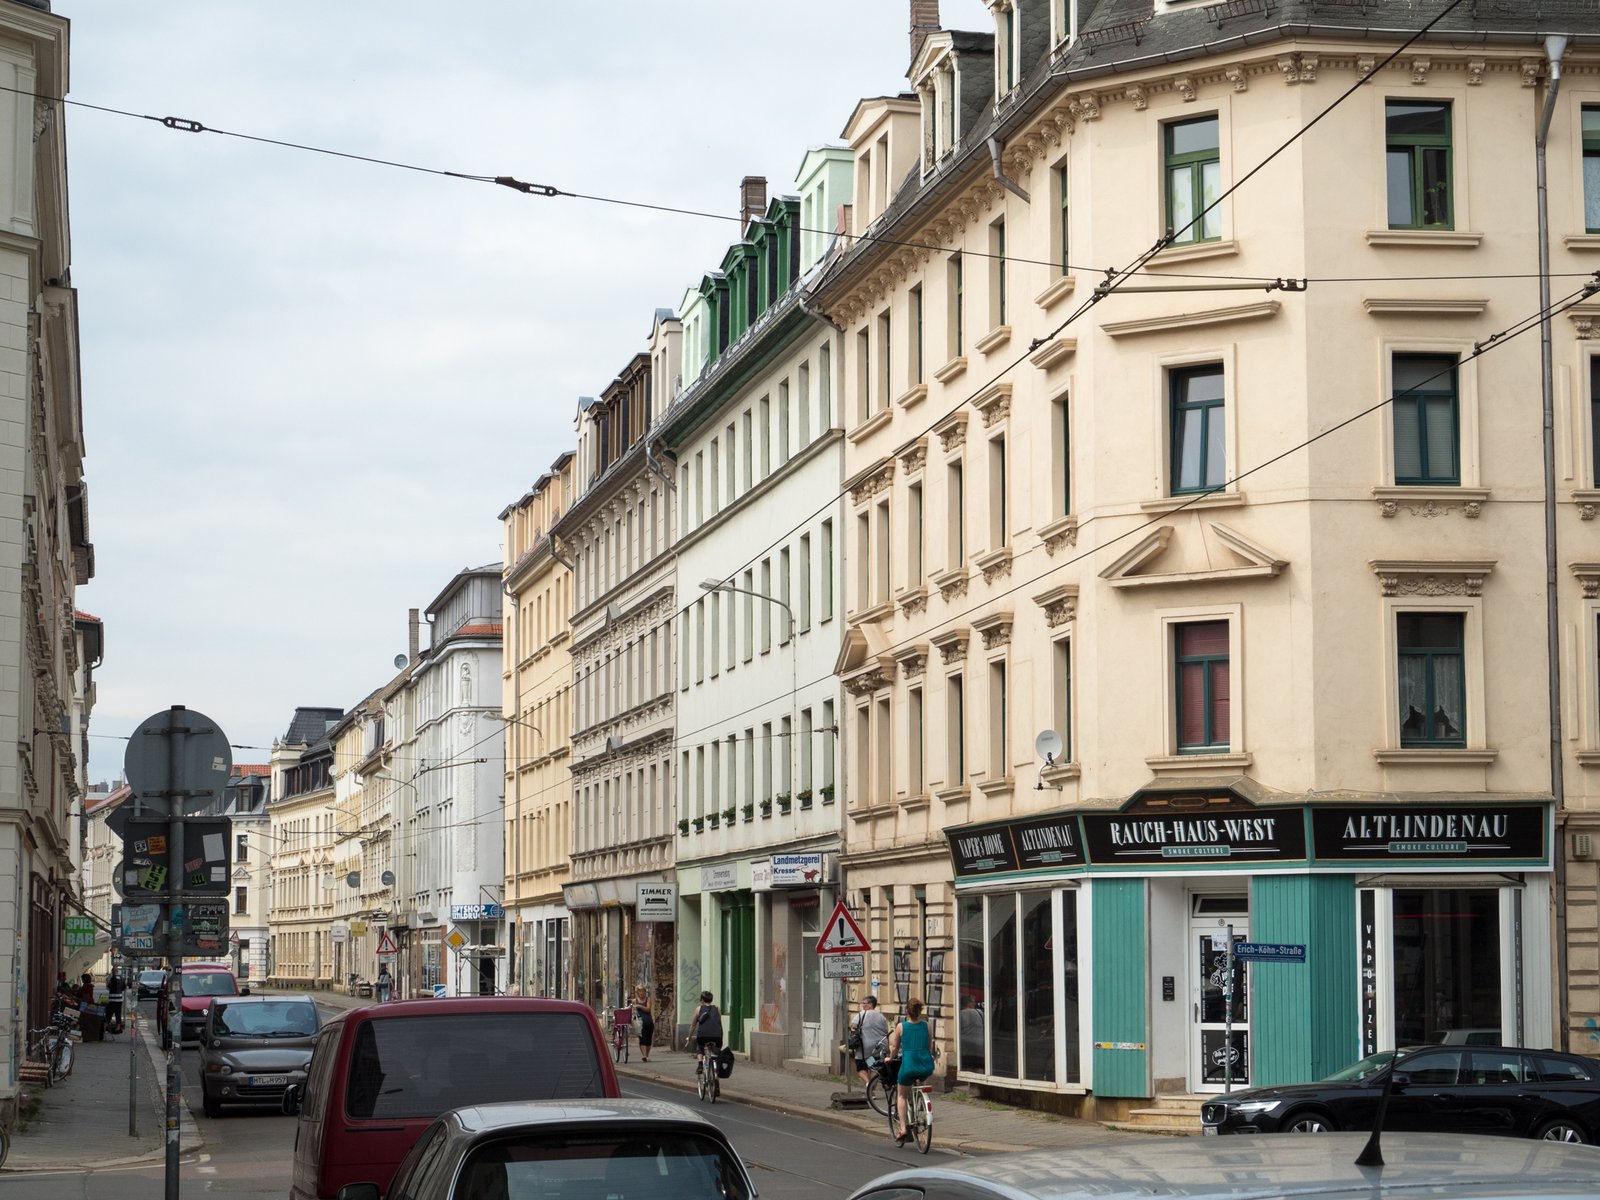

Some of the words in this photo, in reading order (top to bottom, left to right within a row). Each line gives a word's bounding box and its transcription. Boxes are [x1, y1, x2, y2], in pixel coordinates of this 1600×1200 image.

[1110, 818, 1275, 845] RAUCH-HAUS-WEST
[1342, 814, 1508, 838] ALTLINDENAU
[983, 833, 1005, 855] HOME
[1021, 824, 1073, 851] ALTLINDENAU
[773, 854, 820, 866] Landmetzgerei
[66, 918, 94, 930] SPIEL
[66, 932, 94, 945] BAR
[1237, 944, 1302, 955] Erich-Köhn-Straße
